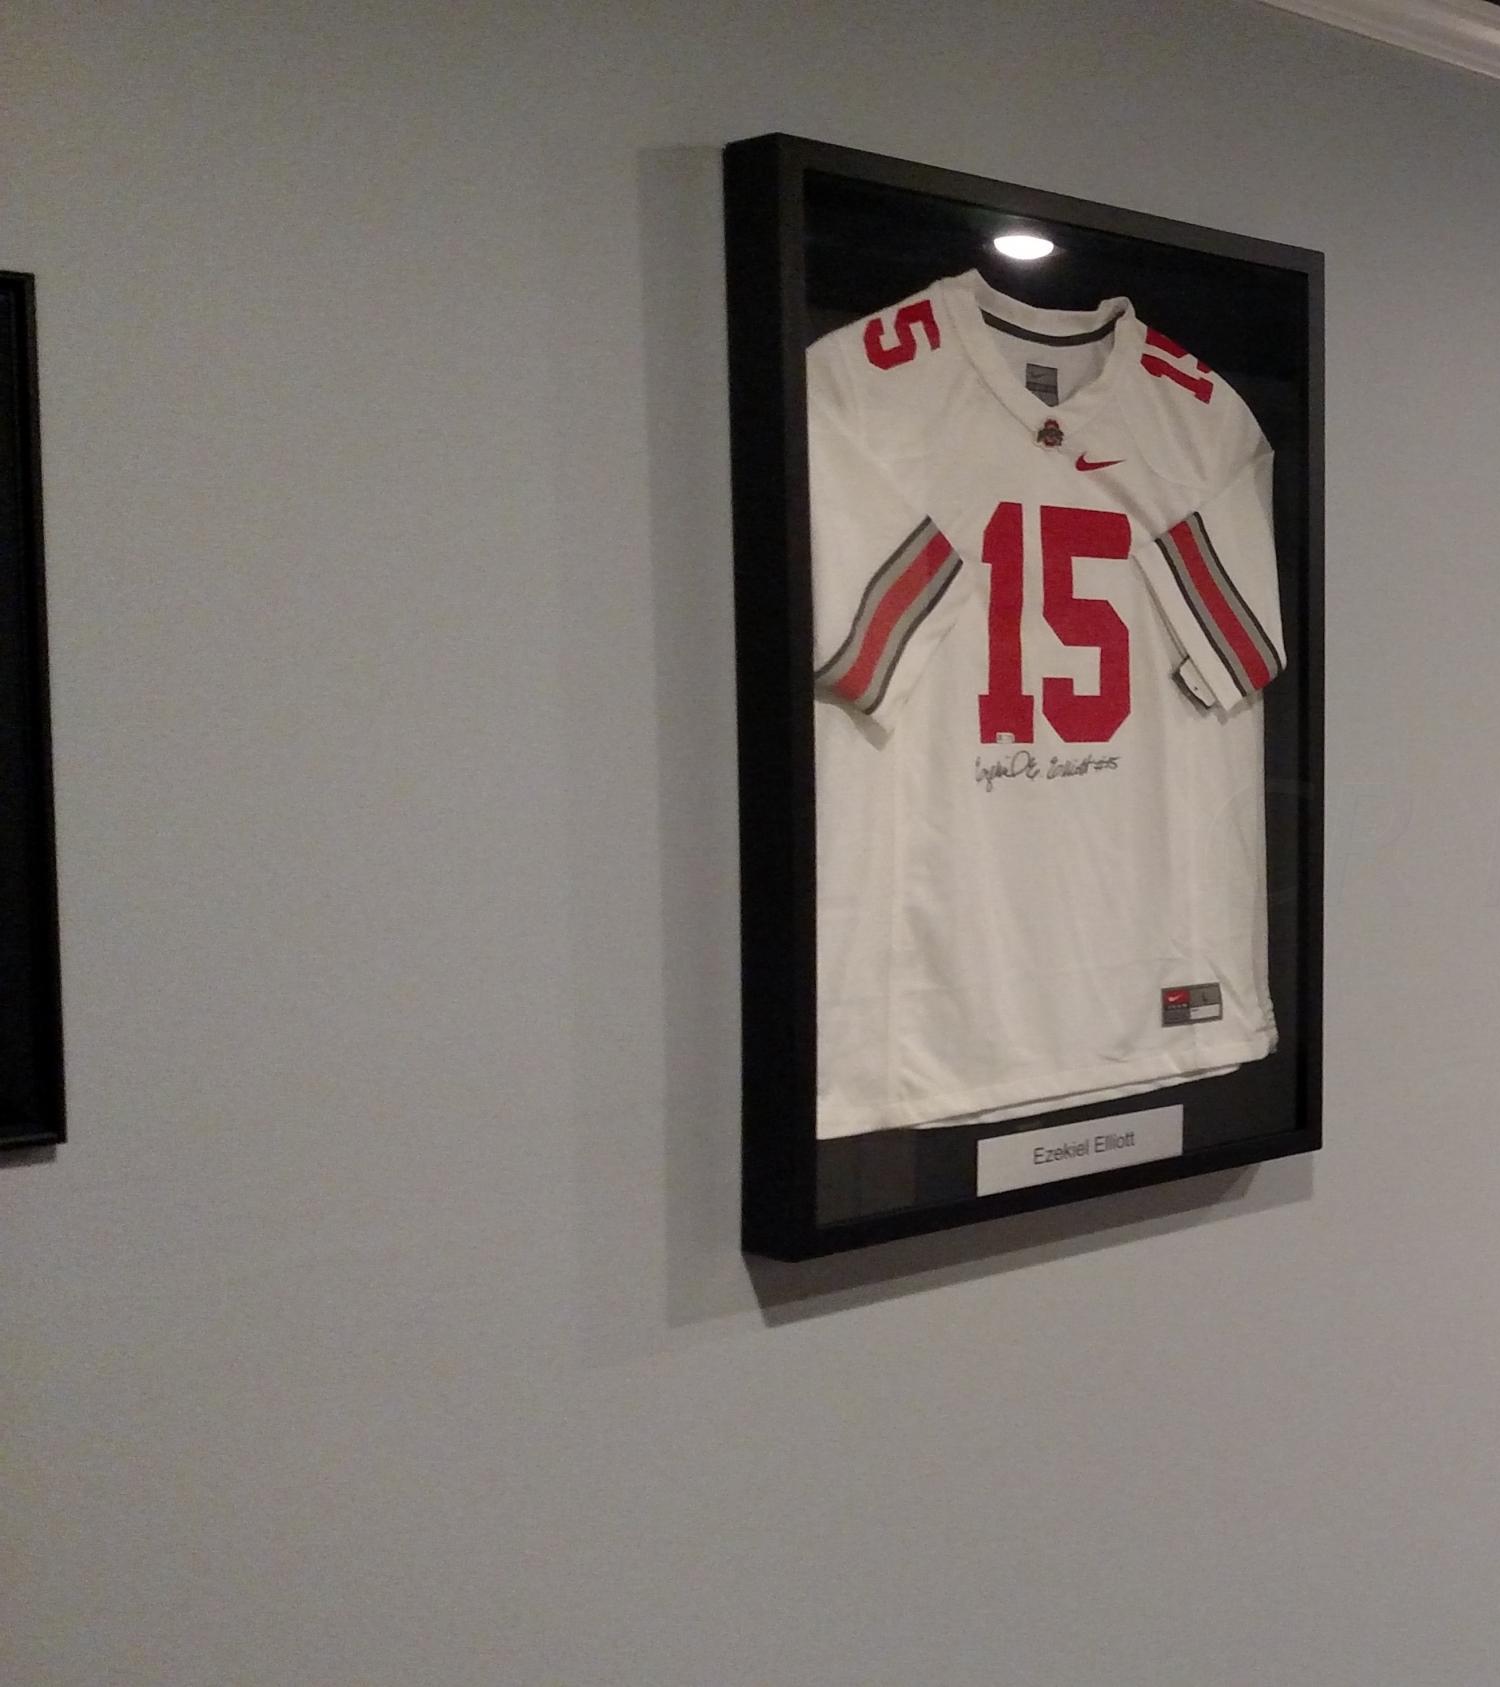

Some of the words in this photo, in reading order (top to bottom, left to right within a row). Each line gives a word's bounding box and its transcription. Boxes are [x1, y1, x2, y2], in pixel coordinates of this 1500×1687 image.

[978, 501, 1131, 743] 15
[1033, 1139, 1090, 1165] Ezekiel
[1094, 1131, 1136, 1153] Elliott
